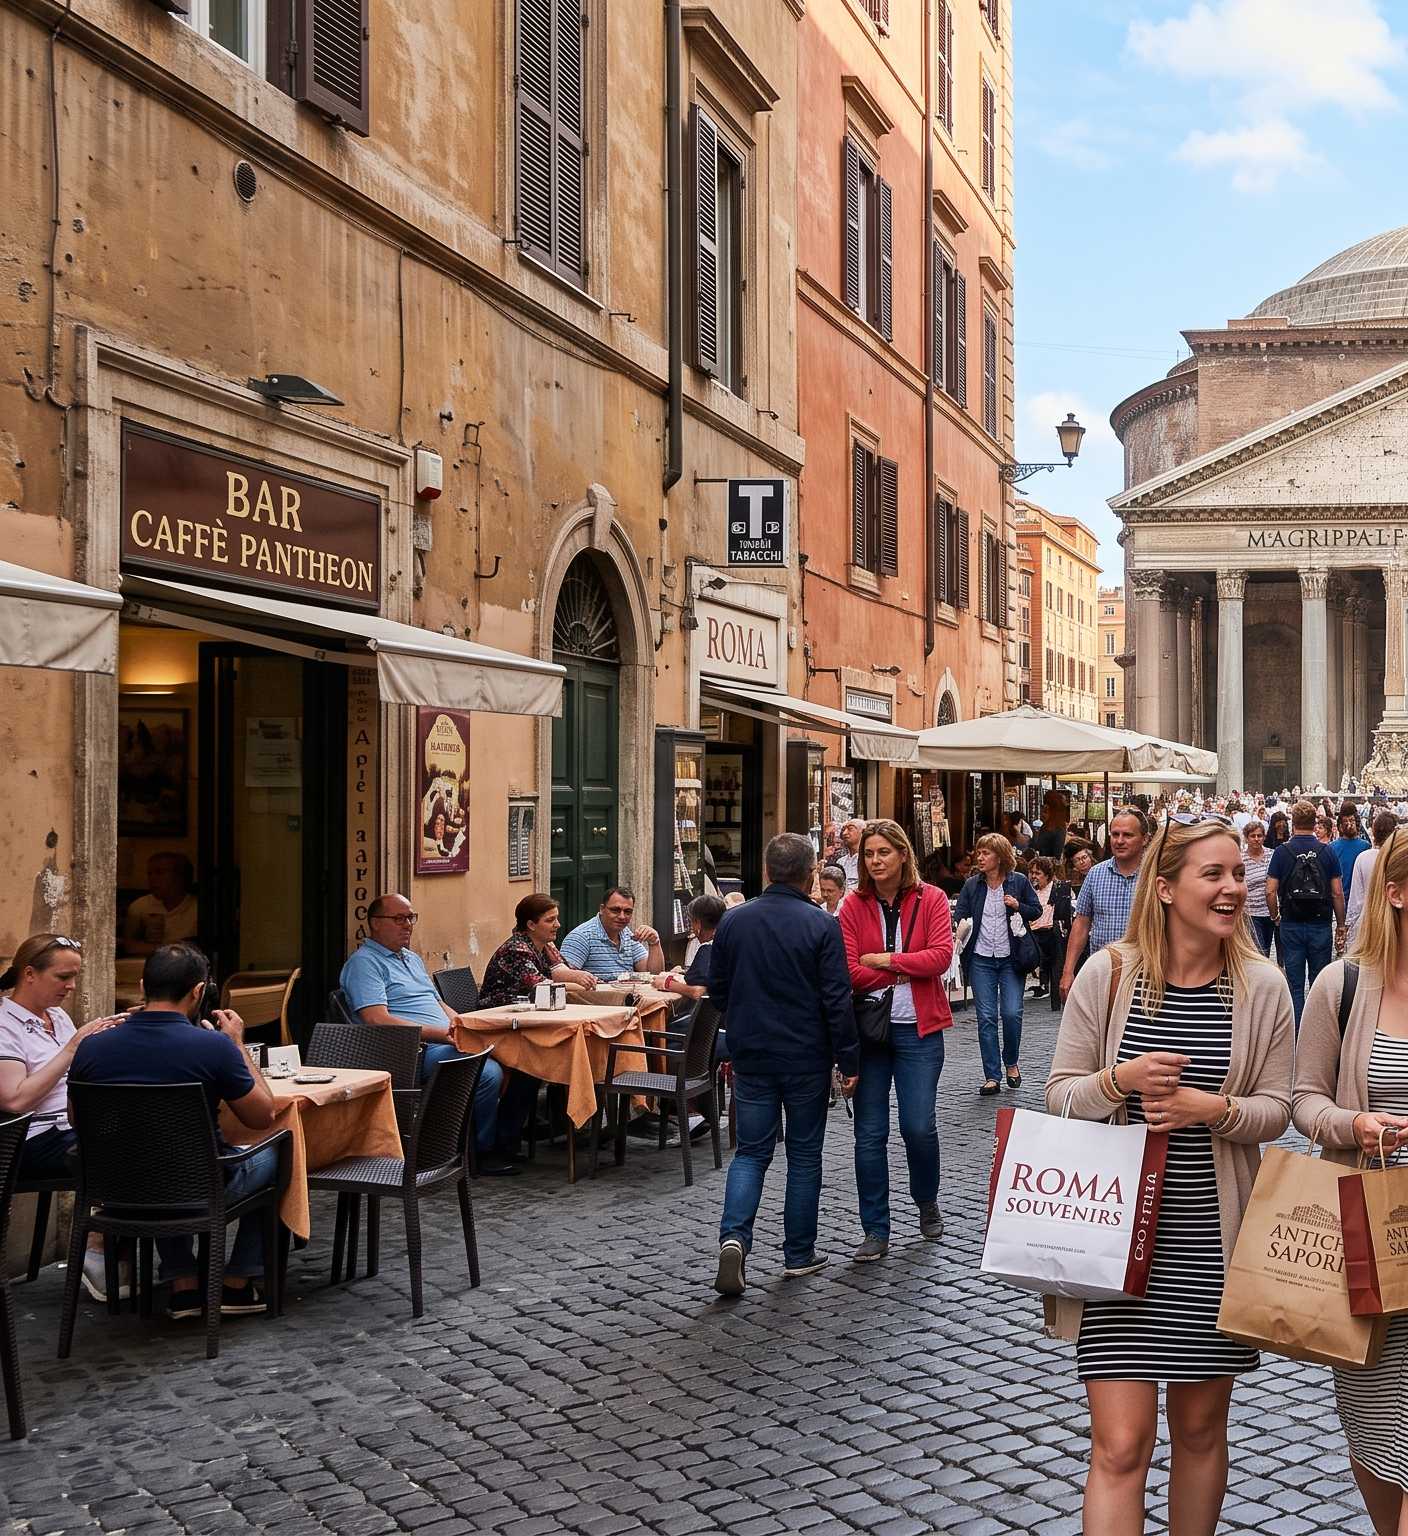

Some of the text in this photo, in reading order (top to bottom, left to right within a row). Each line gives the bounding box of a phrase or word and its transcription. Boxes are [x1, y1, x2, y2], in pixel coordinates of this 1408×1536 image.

[226, 471, 303, 533] BAR
[130, 509, 374, 593] CAFFÈ PANTHEON
[730, 550, 781, 561] TABACCHI
[706, 616, 769, 670] ROMA
[1009, 1162, 1125, 1205] ROMA
[1005, 1197, 1122, 1226] SOUVENIRS
[1267, 1241, 1344, 1274] SAPORI
[1269, 1223, 1344, 1254] ANTICH
